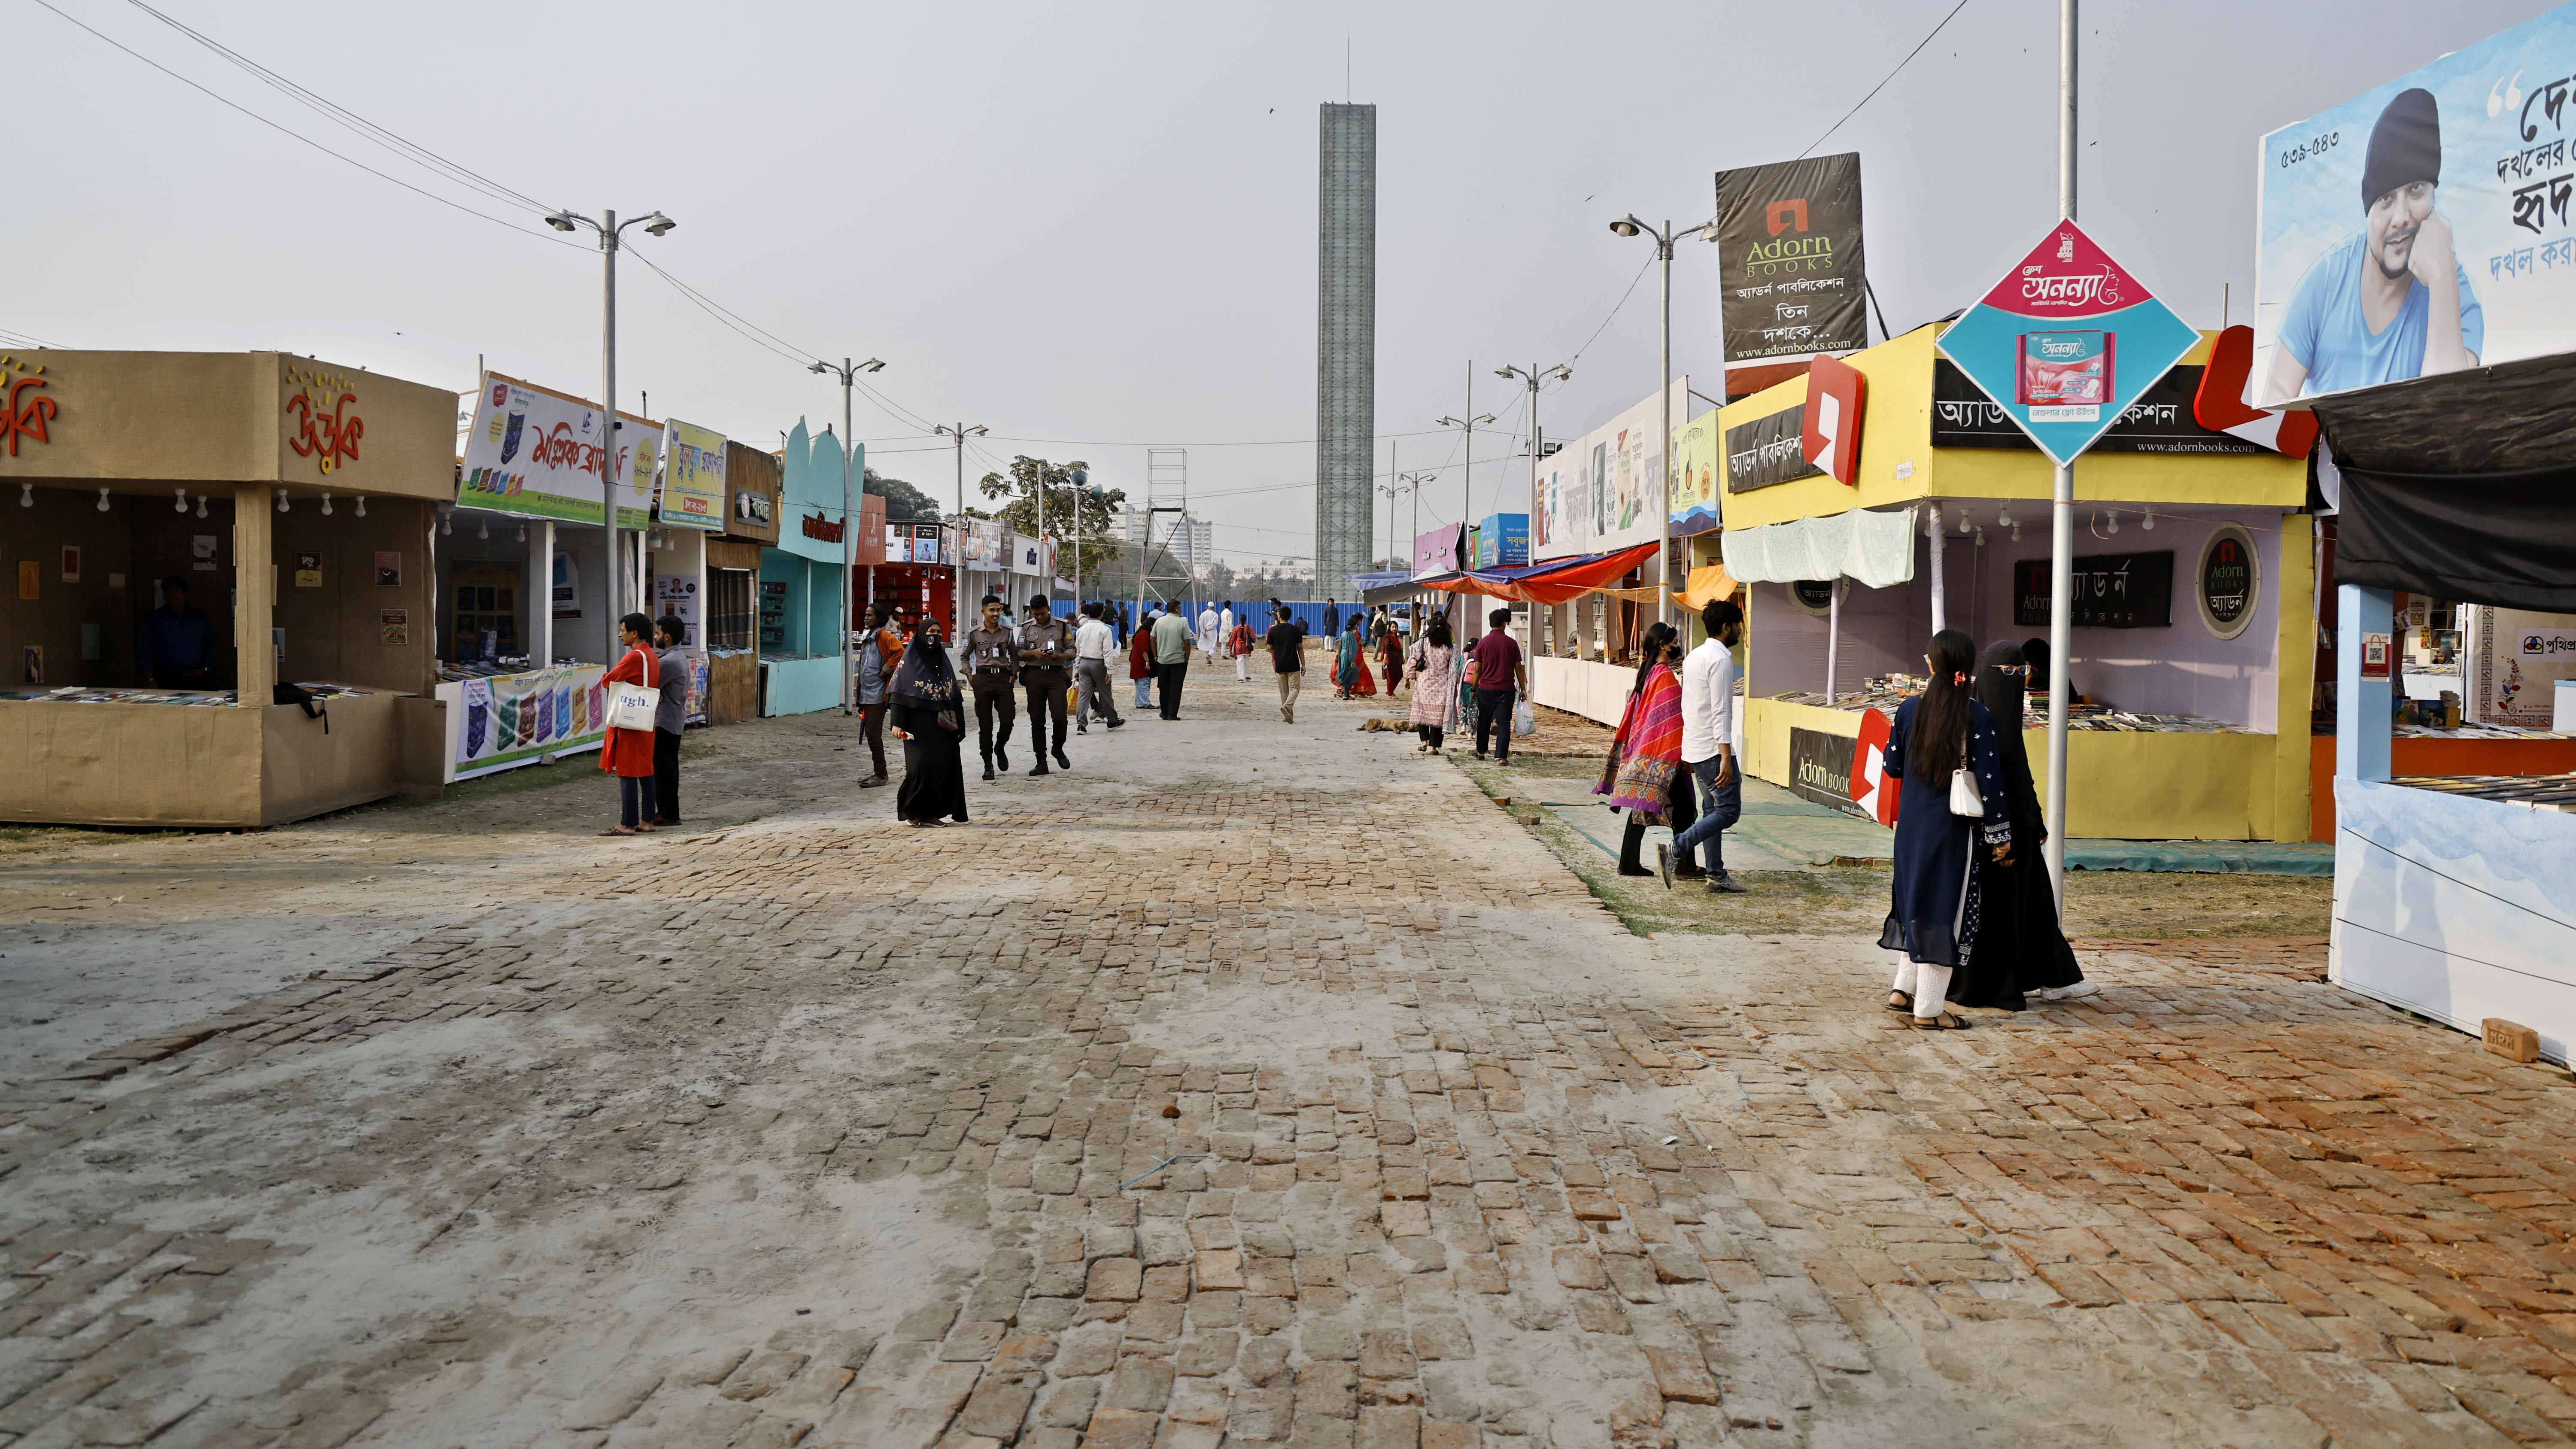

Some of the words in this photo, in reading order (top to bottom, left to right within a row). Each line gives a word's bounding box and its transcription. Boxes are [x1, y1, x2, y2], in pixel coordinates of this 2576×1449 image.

[2281, 131, 2339, 168] ৫৩৯-৫৪৩
[2497, 138, 2565, 184] দখলের
[1747, 237, 1832, 261] Adorn
[1747, 256, 1833, 277] BOOKS
[2022, 265, 2044, 276] ফ্রেশ
[2490, 246, 2534, 282] দখল
[1736, 282, 1773, 299] অ্যাডর্ন
[1777, 277, 1844, 295] পাবলিকেশন
[2022, 275, 2104, 307] অনন্যা
[1775, 302, 1809, 321] তিন
[1736, 339, 1851, 359] www.adornbooks.com
[1936, 398, 2005, 428] অ্যাড
[2062, 409, 2074, 417] ফ্লো
[2076, 407, 2096, 416] উইংস
[1730, 438, 1758, 477] অ্যাডর্ন
[1759, 434, 1802, 468] পাবলিকেশ
[2137, 441, 2255, 453] www.adornbooks.com
[677, 442, 702, 484] বুলবুল
[702, 440, 725, 480] প্রকাশনী
[1506, 537, 1529, 547] সবুজ
[2211, 565, 2243, 578] Adorn
[1803, 589, 1832, 598] অ্যাডর্ন
[2211, 581, 2243, 589] BOOKS
[2210, 588, 2245, 612] অ্যাডর্ন
[2023, 614, 2052, 623] BOOK
[620, 696, 649, 708] ugh.
[1798, 757, 1827, 788] Adorn
[1828, 772, 1850, 794] BOOK
